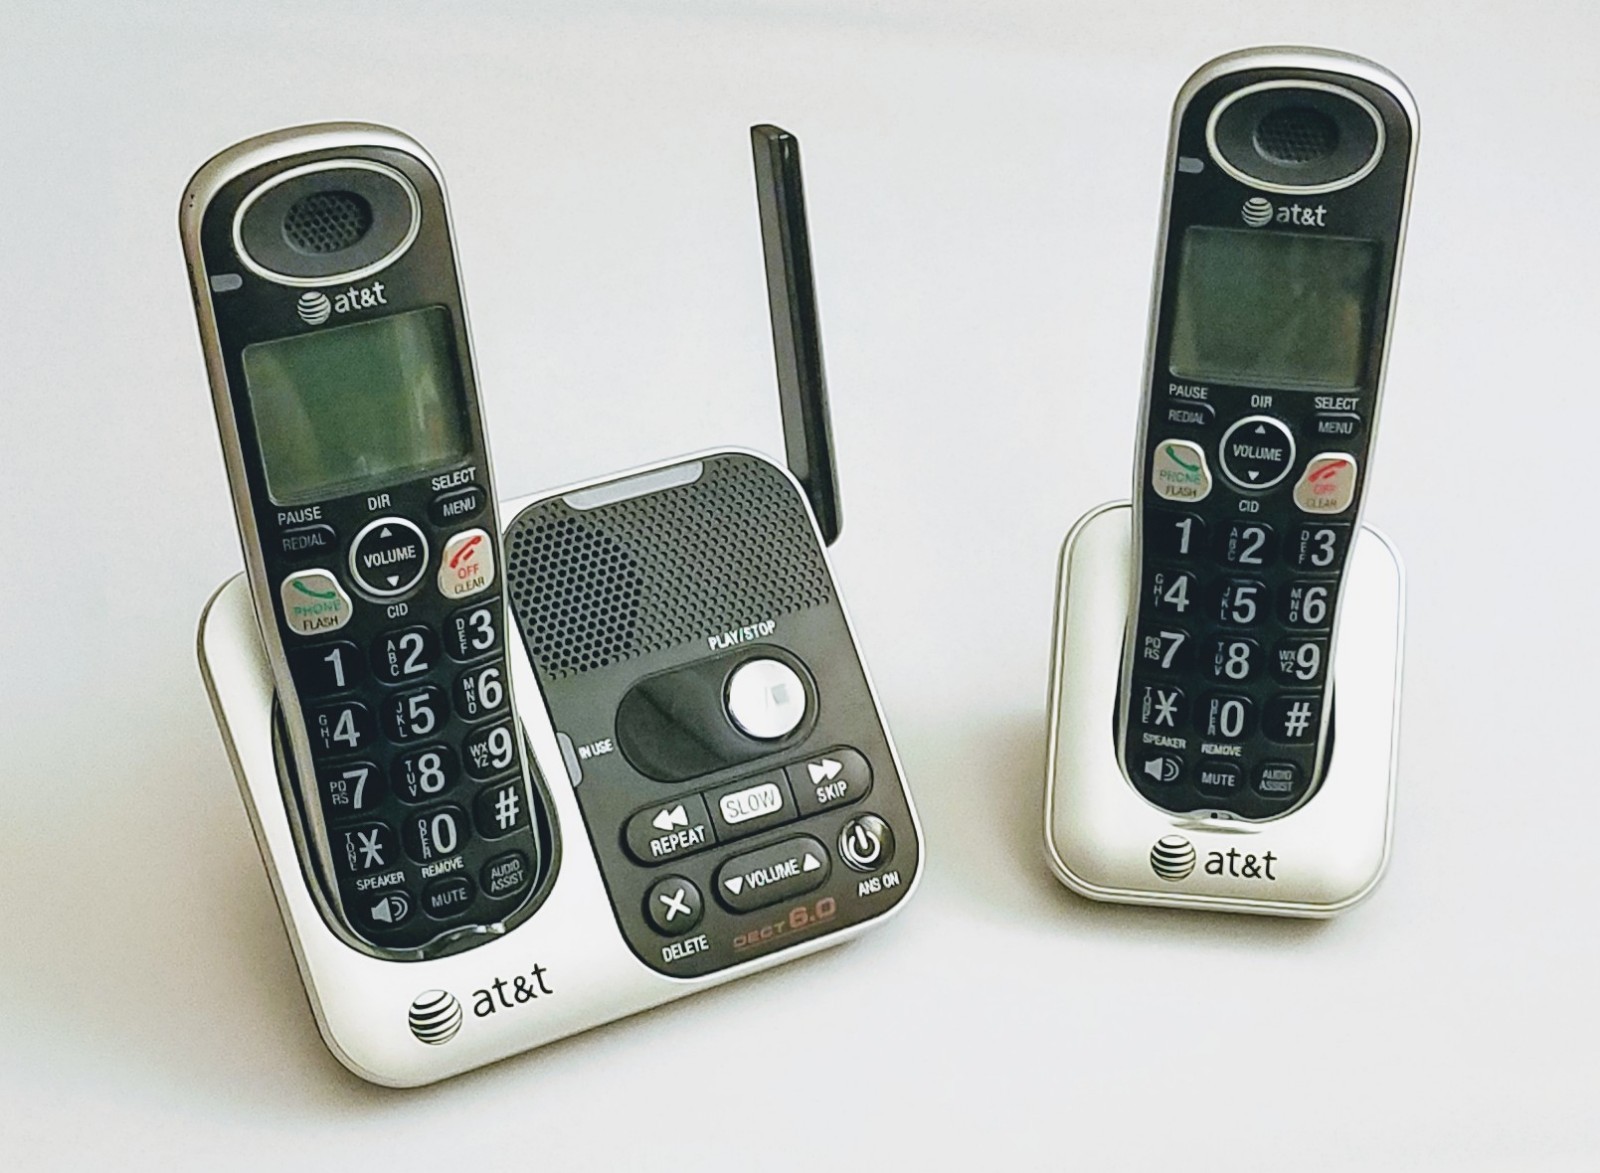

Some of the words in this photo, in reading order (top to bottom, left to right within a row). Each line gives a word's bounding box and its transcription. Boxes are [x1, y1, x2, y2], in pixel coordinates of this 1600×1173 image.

[1276, 204, 1328, 227] at&t
[334, 281, 388, 313] at&t
[1169, 384, 1209, 400] PAUSE
[1251, 395, 1273, 408] DIR
[1314, 396, 1359, 411] SELECT
[1168, 409, 1205, 425] REDIAL
[1318, 421, 1354, 435] MENU
[1232, 444, 1283, 462] VOLUME
[432, 467, 476, 491] SELECT
[1159, 470, 1201, 484] PHONE
[368, 494, 390, 511] DIR
[1165, 485, 1197, 497] FLASH
[278, 506, 322, 525] PAUSE
[443, 496, 476, 517] MENU
[1238, 499, 1260, 513] CID
[283, 533, 326, 551] REDIAL
[1175, 518, 1193, 554] 1
[1239, 527, 1266, 565] 2
[1311, 529, 1336, 567] 3
[363, 545, 416, 568] VOLUME
[458, 564, 479, 580] OFF
[455, 576, 485, 594] CLEAR
[1163, 575, 1190, 613] 4
[293, 601, 341, 617] PHONE
[387, 603, 408, 619] CID
[1231, 587, 1258, 624] 5
[1302, 586, 1328, 625] 6
[303, 616, 339, 630] FLASH
[469, 609, 495, 650] 3
[708, 620, 776, 651] PLAY/STOP
[400, 632, 428, 674] 2
[1160, 631, 1186, 669] 7
[1224, 642, 1250, 680] 8
[1295, 643, 1321, 680] 9
[324, 648, 345, 687] 1
[478, 668, 503, 710] 6
[409, 693, 435, 735] 5
[1220, 700, 1245, 738] 0
[1284, 702, 1312, 738] #
[333, 709, 360, 747] 4
[488, 727, 513, 769] 9
[578, 745, 593, 760] IN
[593, 738, 614, 757] USE
[1142, 733, 1187, 749] SPEAKER
[1201, 744, 1243, 757] REMOVE
[418, 753, 445, 793] 8
[1202, 772, 1236, 787] MUTE
[1262, 769, 1293, 780] AUDIO
[342, 768, 369, 809] 7
[815, 780, 848, 804] SKIP
[1259, 781, 1294, 792] ASSIST
[494, 786, 520, 830] #
[726, 789, 776, 819] SLOW
[431, 813, 457, 854] 0
[650, 825, 705, 857] REPEAT
[421, 856, 465, 878] REMOVE
[490, 859, 520, 879] AUDIO
[745, 859, 801, 889] VOLUME
[1204, 847, 1278, 881] at&t
[356, 871, 405, 891] SPEAKER
[490, 870, 525, 893] ASSIST
[858, 878, 882, 897] ANS
[882, 871, 900, 888] ON
[431, 888, 468, 909] MUTE
[733, 921, 786, 948] DECT
[788, 897, 836, 930] 6.0
[661, 934, 709, 963] DELETE
[472, 963, 553, 1018] at&t
